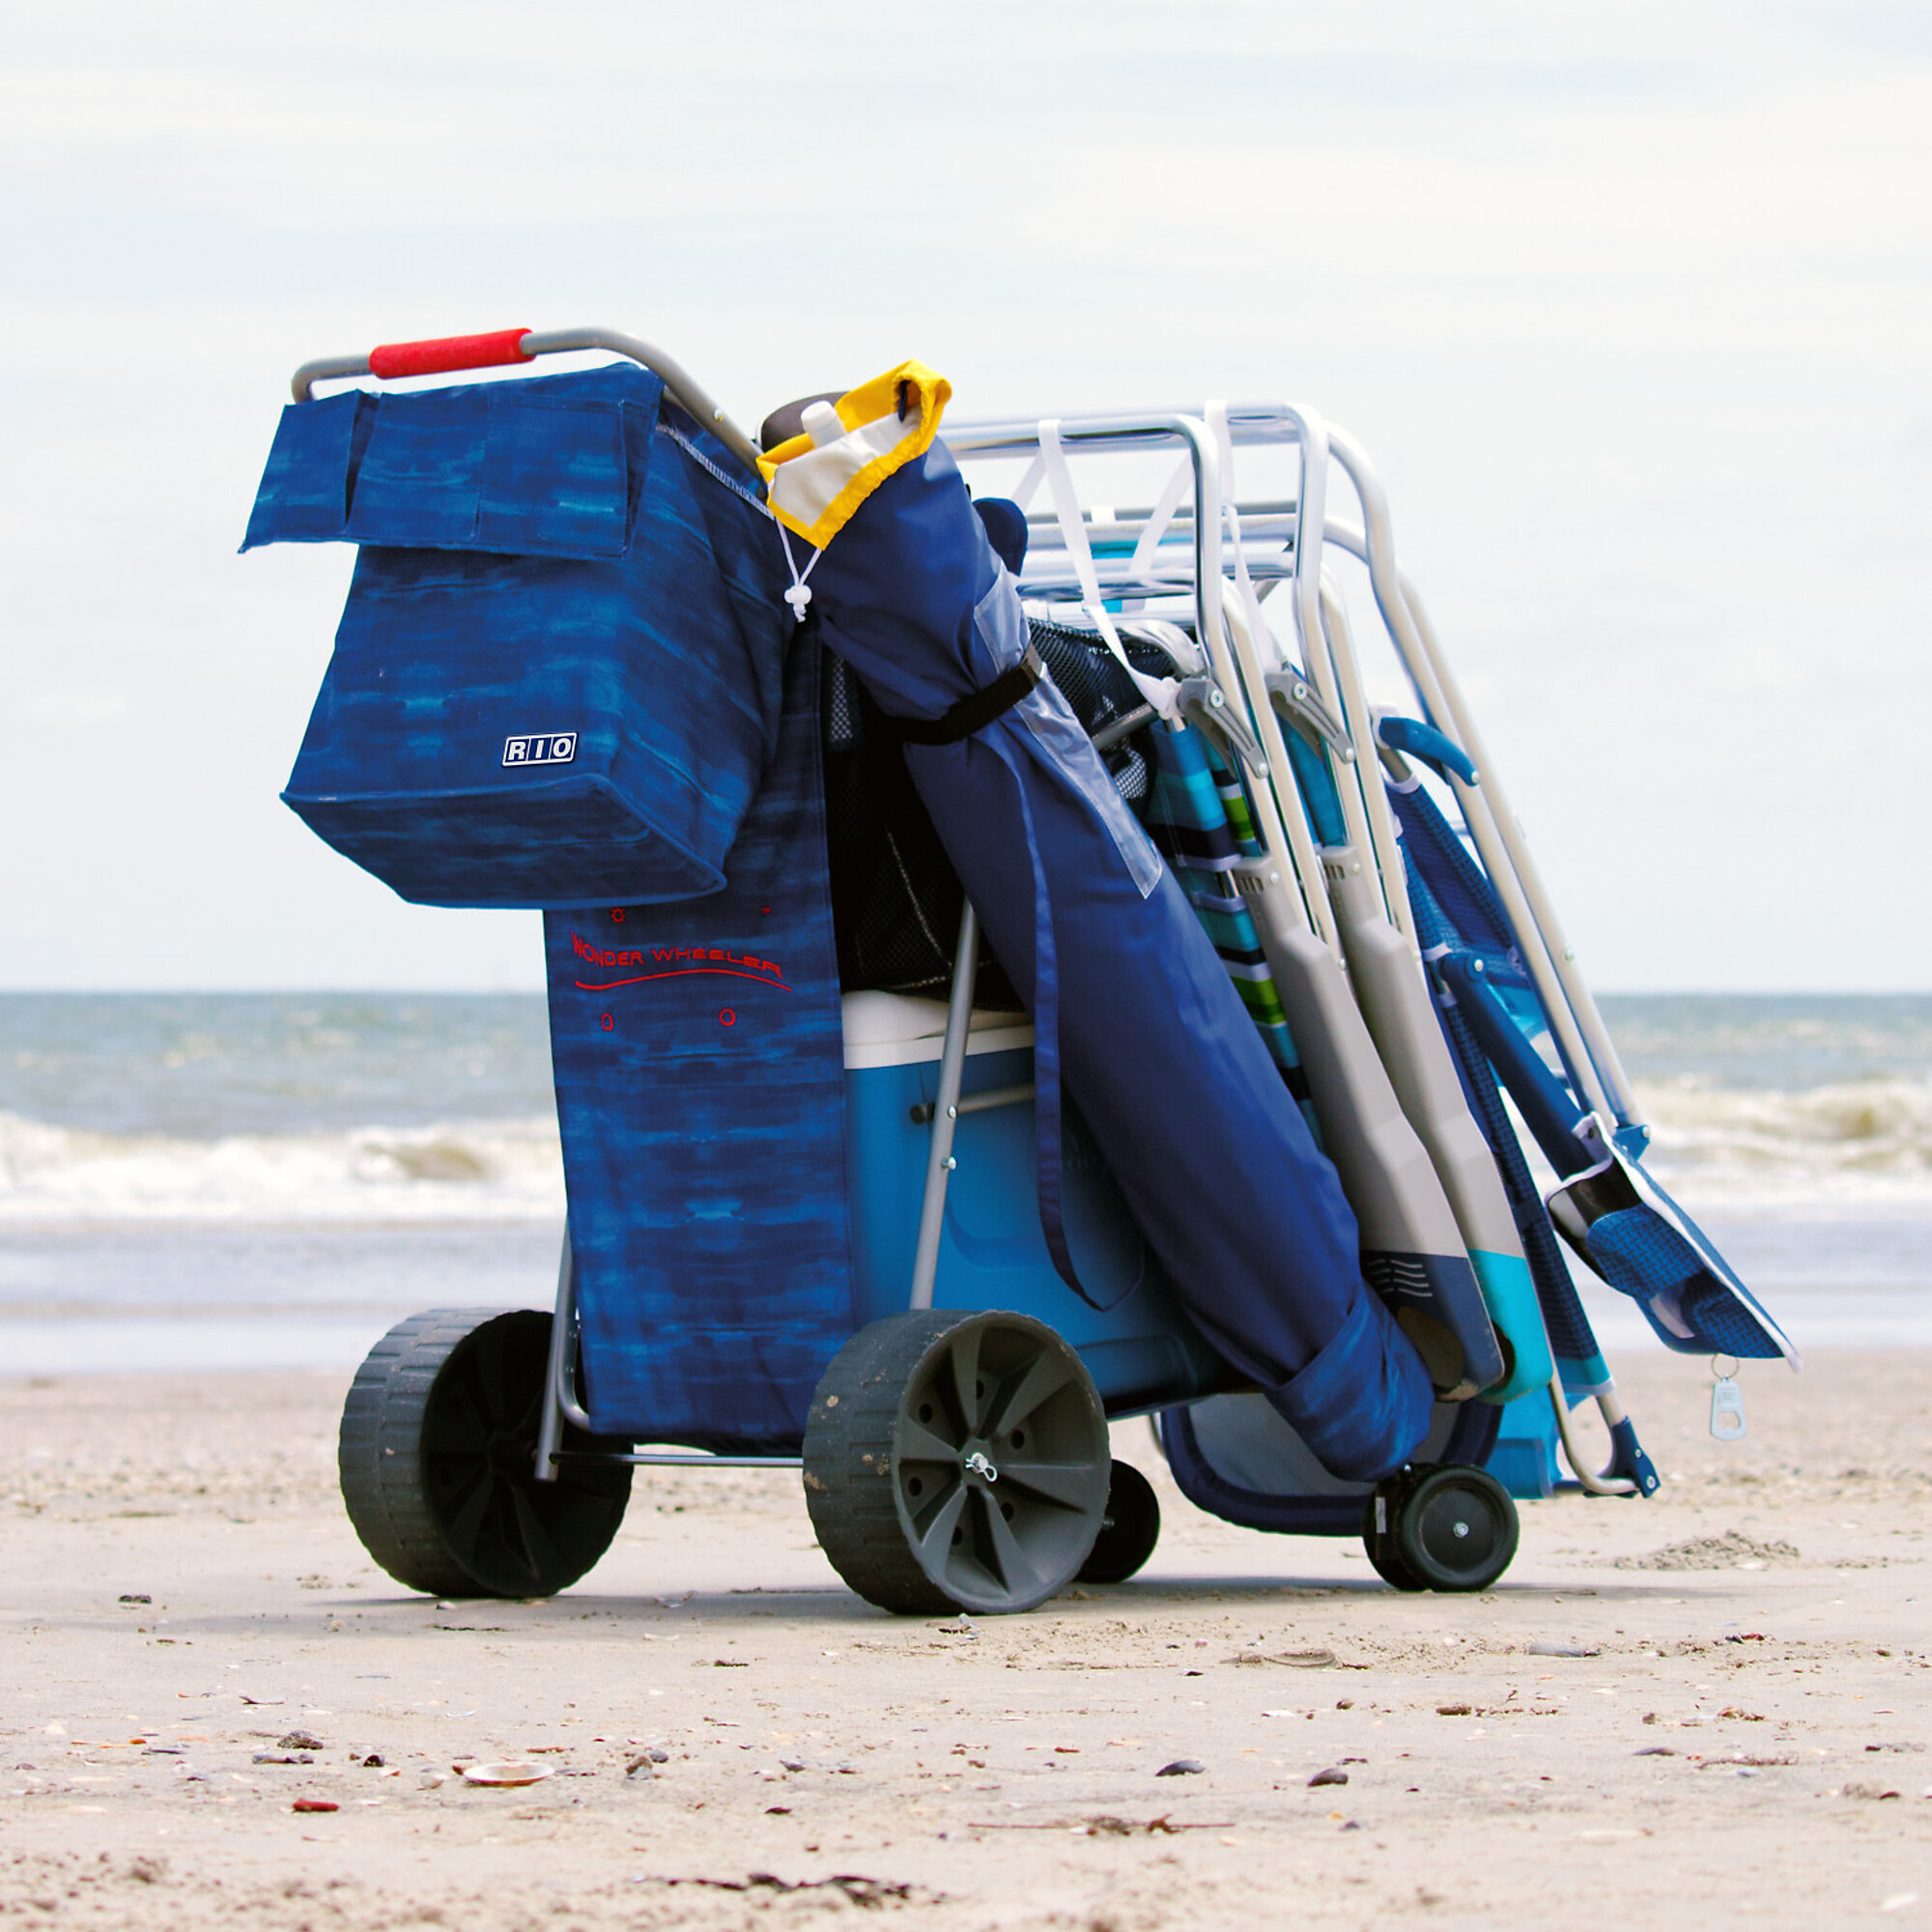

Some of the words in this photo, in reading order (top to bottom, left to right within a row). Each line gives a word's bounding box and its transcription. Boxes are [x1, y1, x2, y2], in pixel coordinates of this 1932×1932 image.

[507, 738, 572, 760] RIO
[570, 928, 645, 968] WONDER
[650, 947, 783, 979] WHEELER
